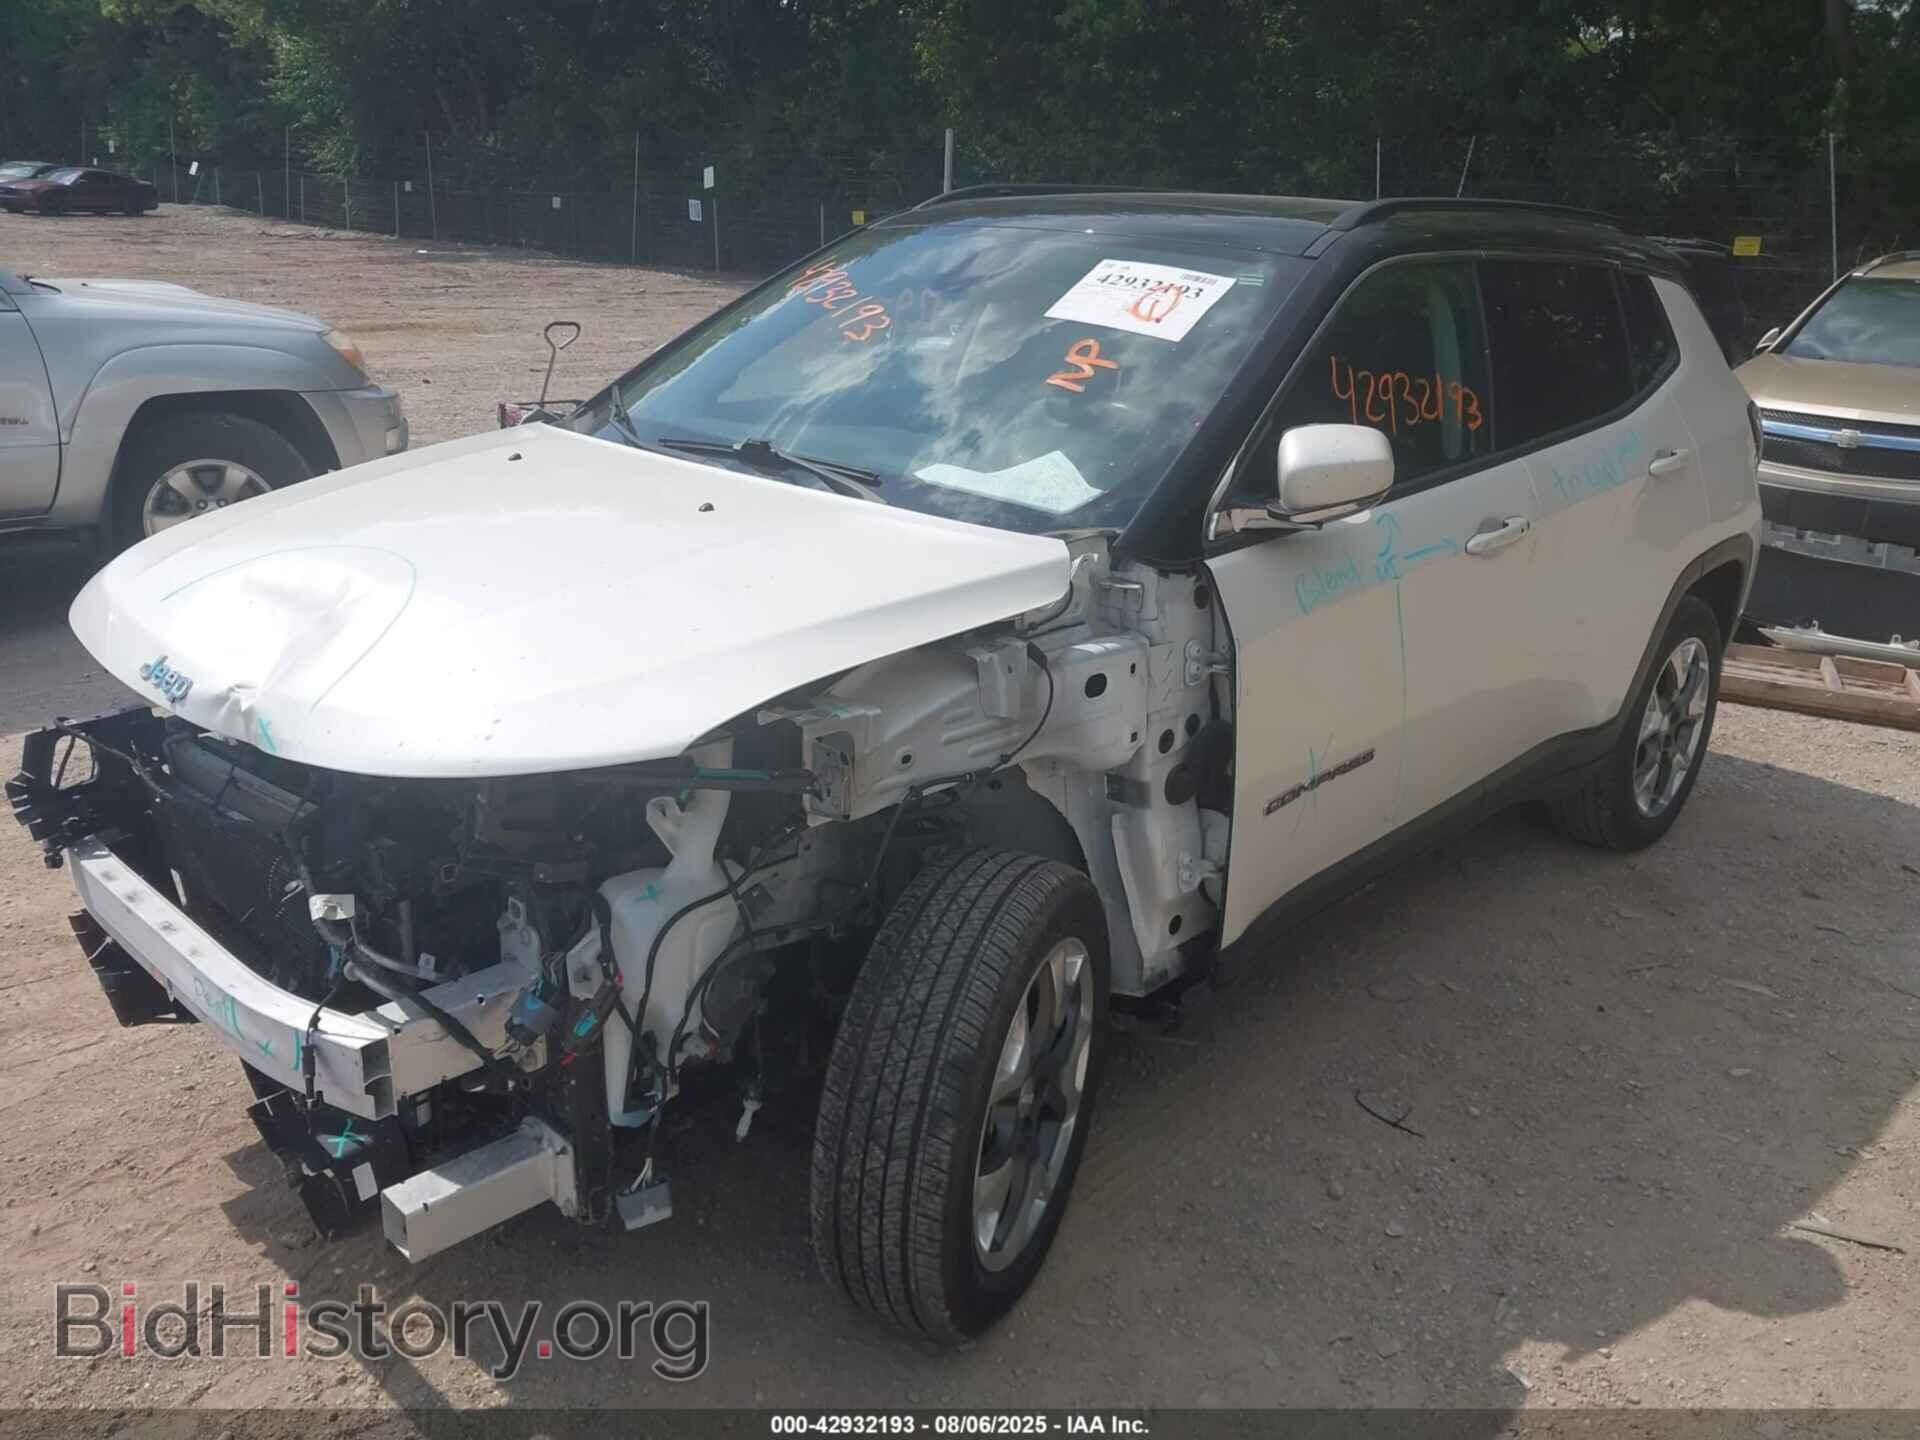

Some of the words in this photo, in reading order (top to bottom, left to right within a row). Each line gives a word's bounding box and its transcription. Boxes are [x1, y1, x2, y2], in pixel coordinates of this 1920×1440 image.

[1096, 272, 1204, 300] 42932193
[1329, 355, 1484, 433] 42932193
[139, 655, 194, 704] Jeep
